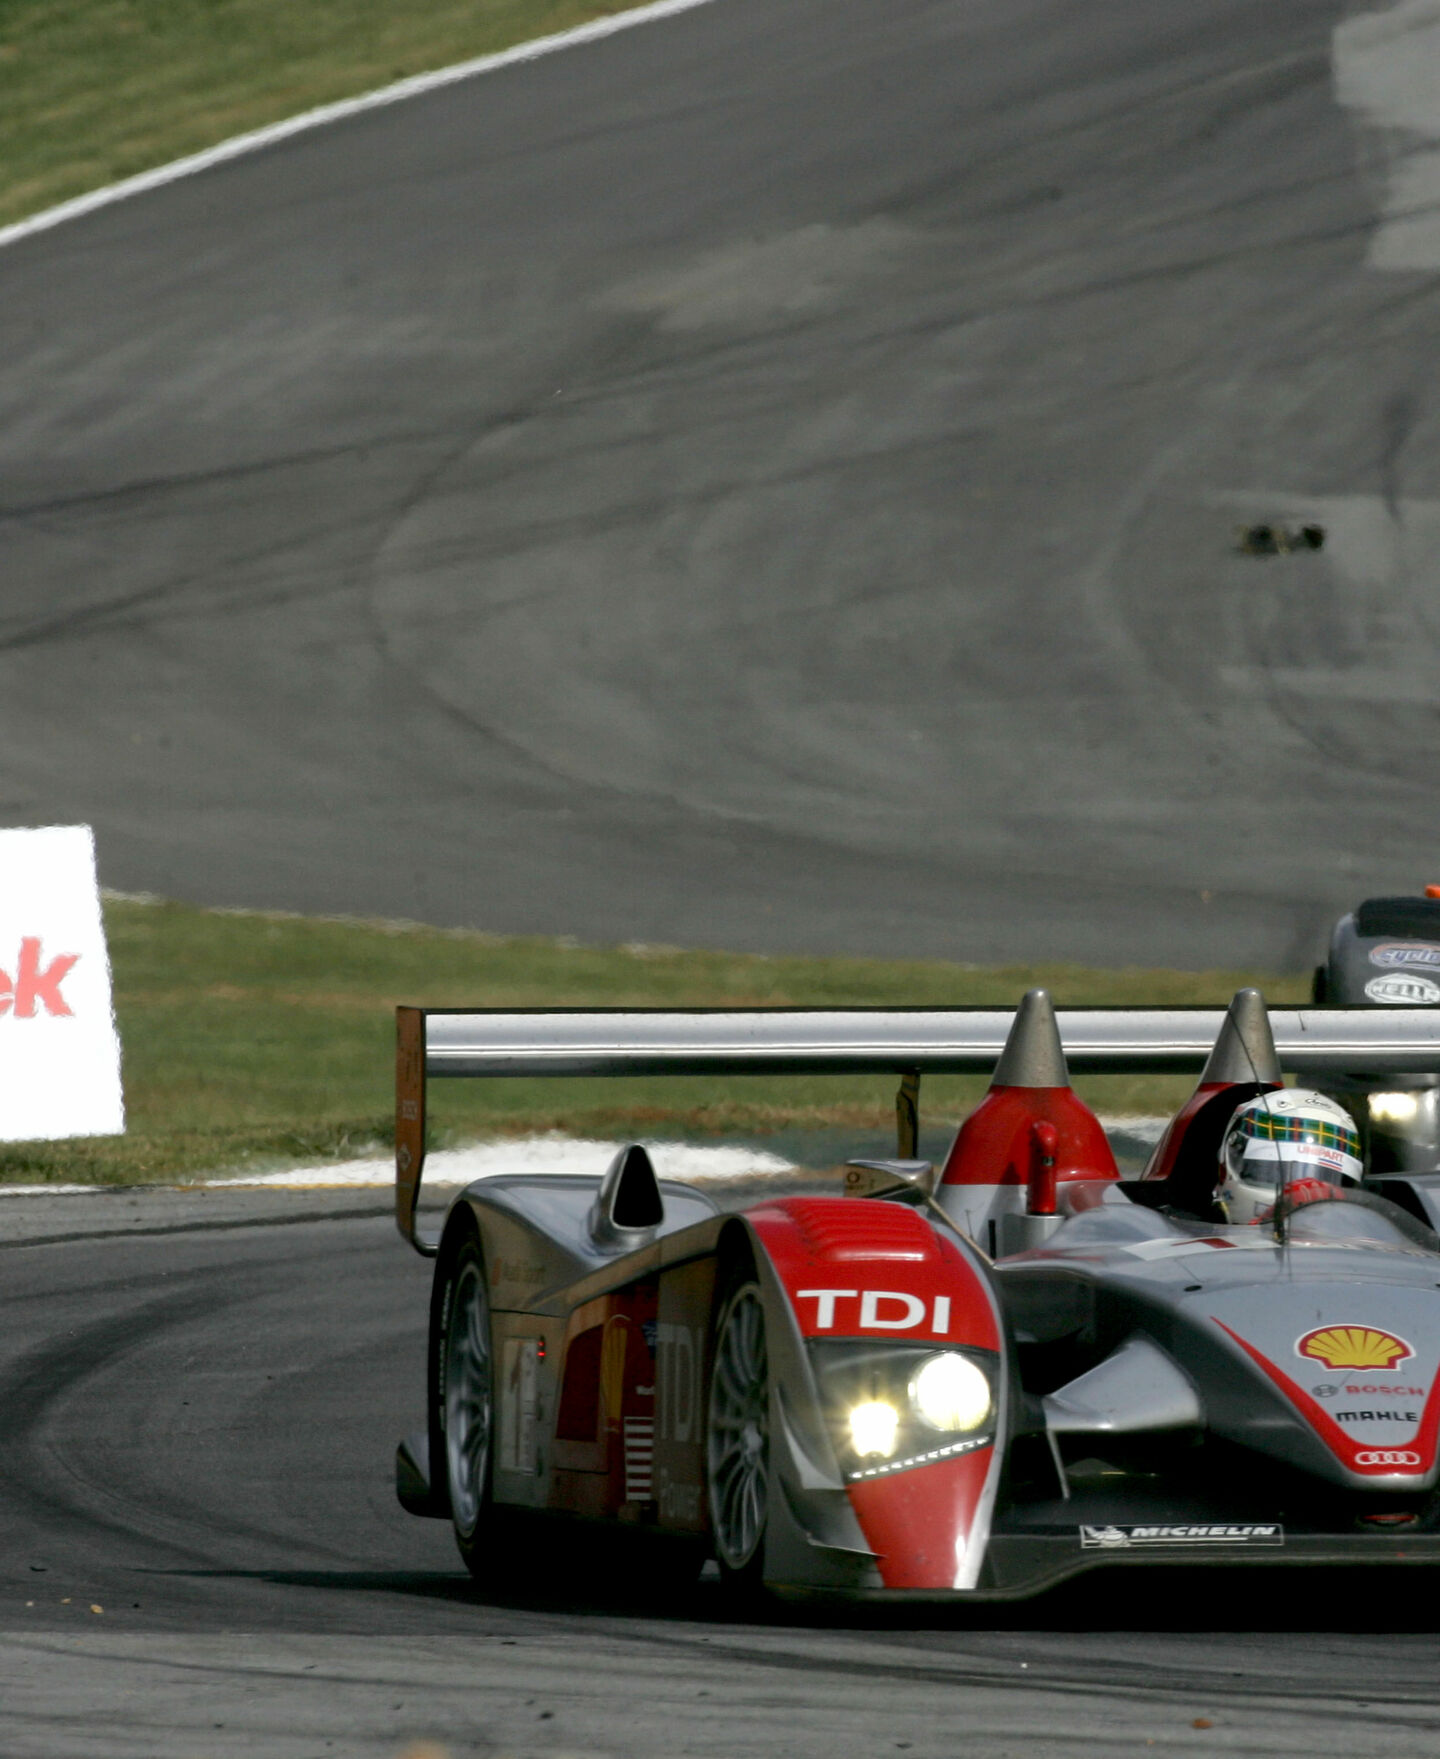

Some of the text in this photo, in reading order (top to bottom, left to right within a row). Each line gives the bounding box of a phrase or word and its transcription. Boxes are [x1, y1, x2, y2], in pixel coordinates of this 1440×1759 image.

[0, 936, 82, 1019] k
[796, 1289, 951, 1334] TDI
[1345, 1384, 1425, 1397] BOSCH
[1335, 1411, 1419, 1423] MAHLE
[1130, 1526, 1277, 1537] MICHELIN
